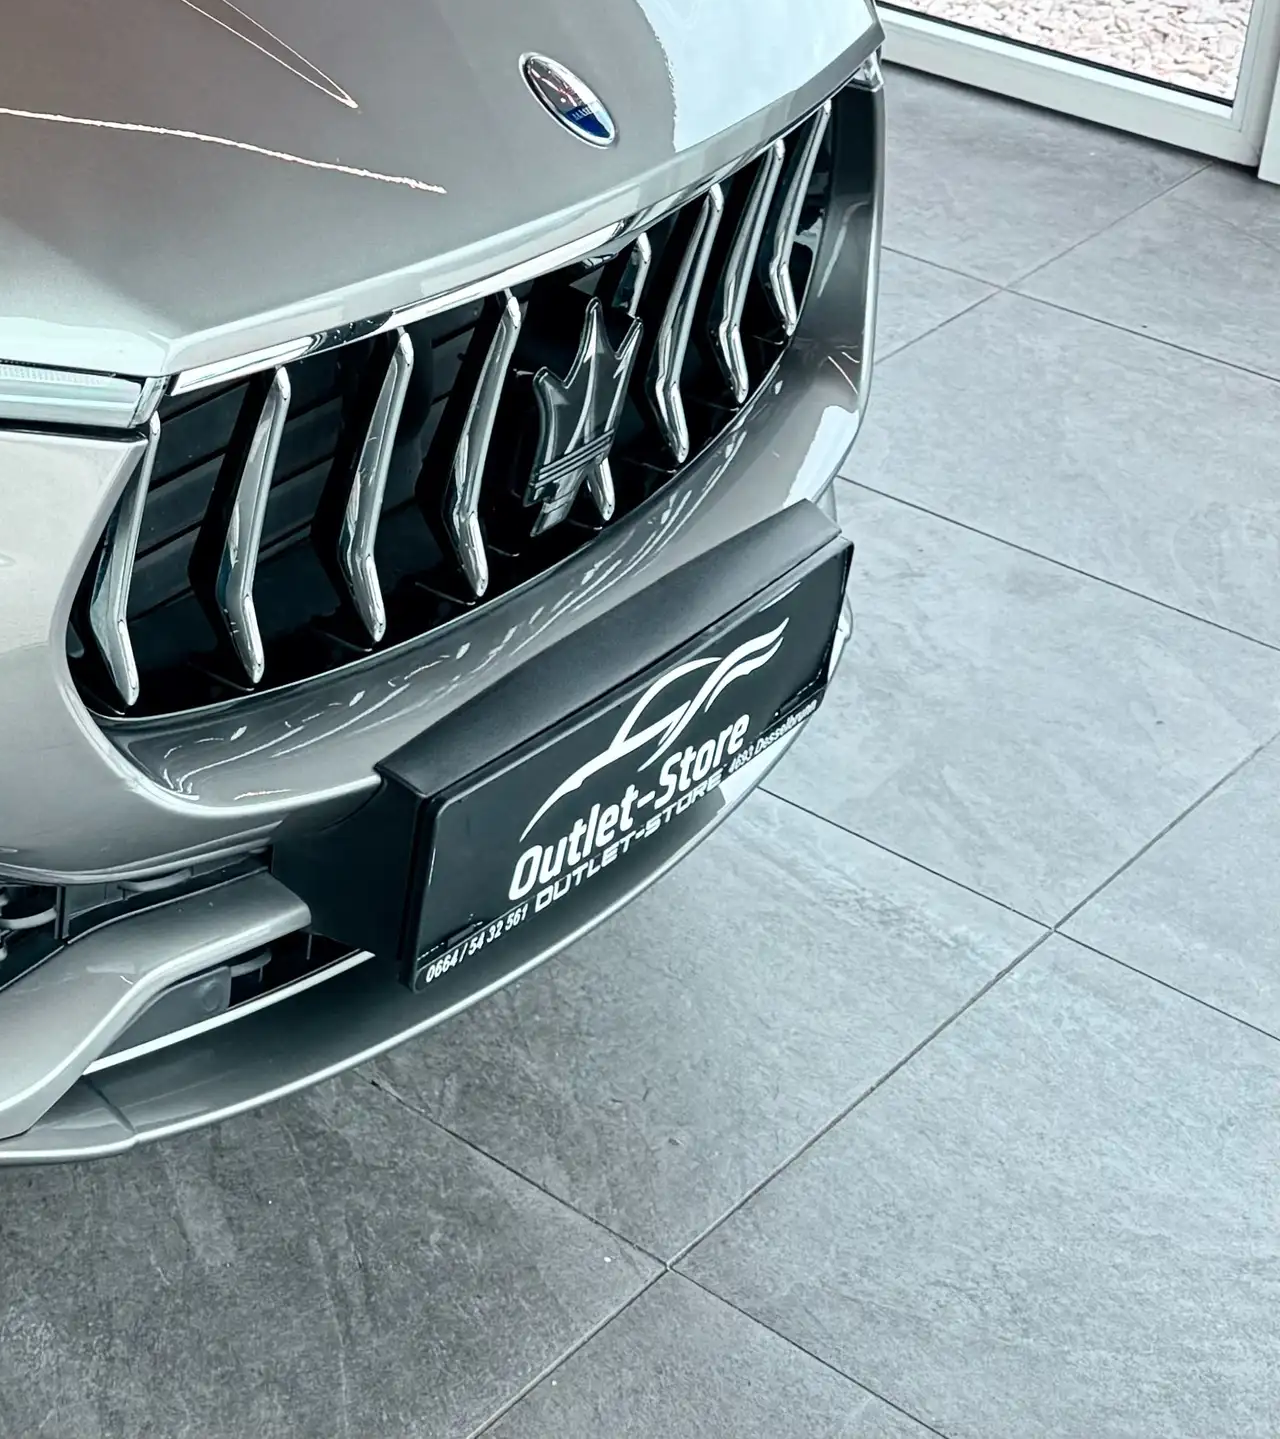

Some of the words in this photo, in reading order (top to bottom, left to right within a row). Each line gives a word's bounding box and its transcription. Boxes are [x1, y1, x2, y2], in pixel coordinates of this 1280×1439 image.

[425, 948, 460, 983] 0664
[468, 931, 486, 956] 54
[486, 919, 504, 943] 32
[504, 903, 529, 931] 561
[534, 767, 725, 913] OUTLET-STORE
[507, 713, 750, 901] Outlet-Store
